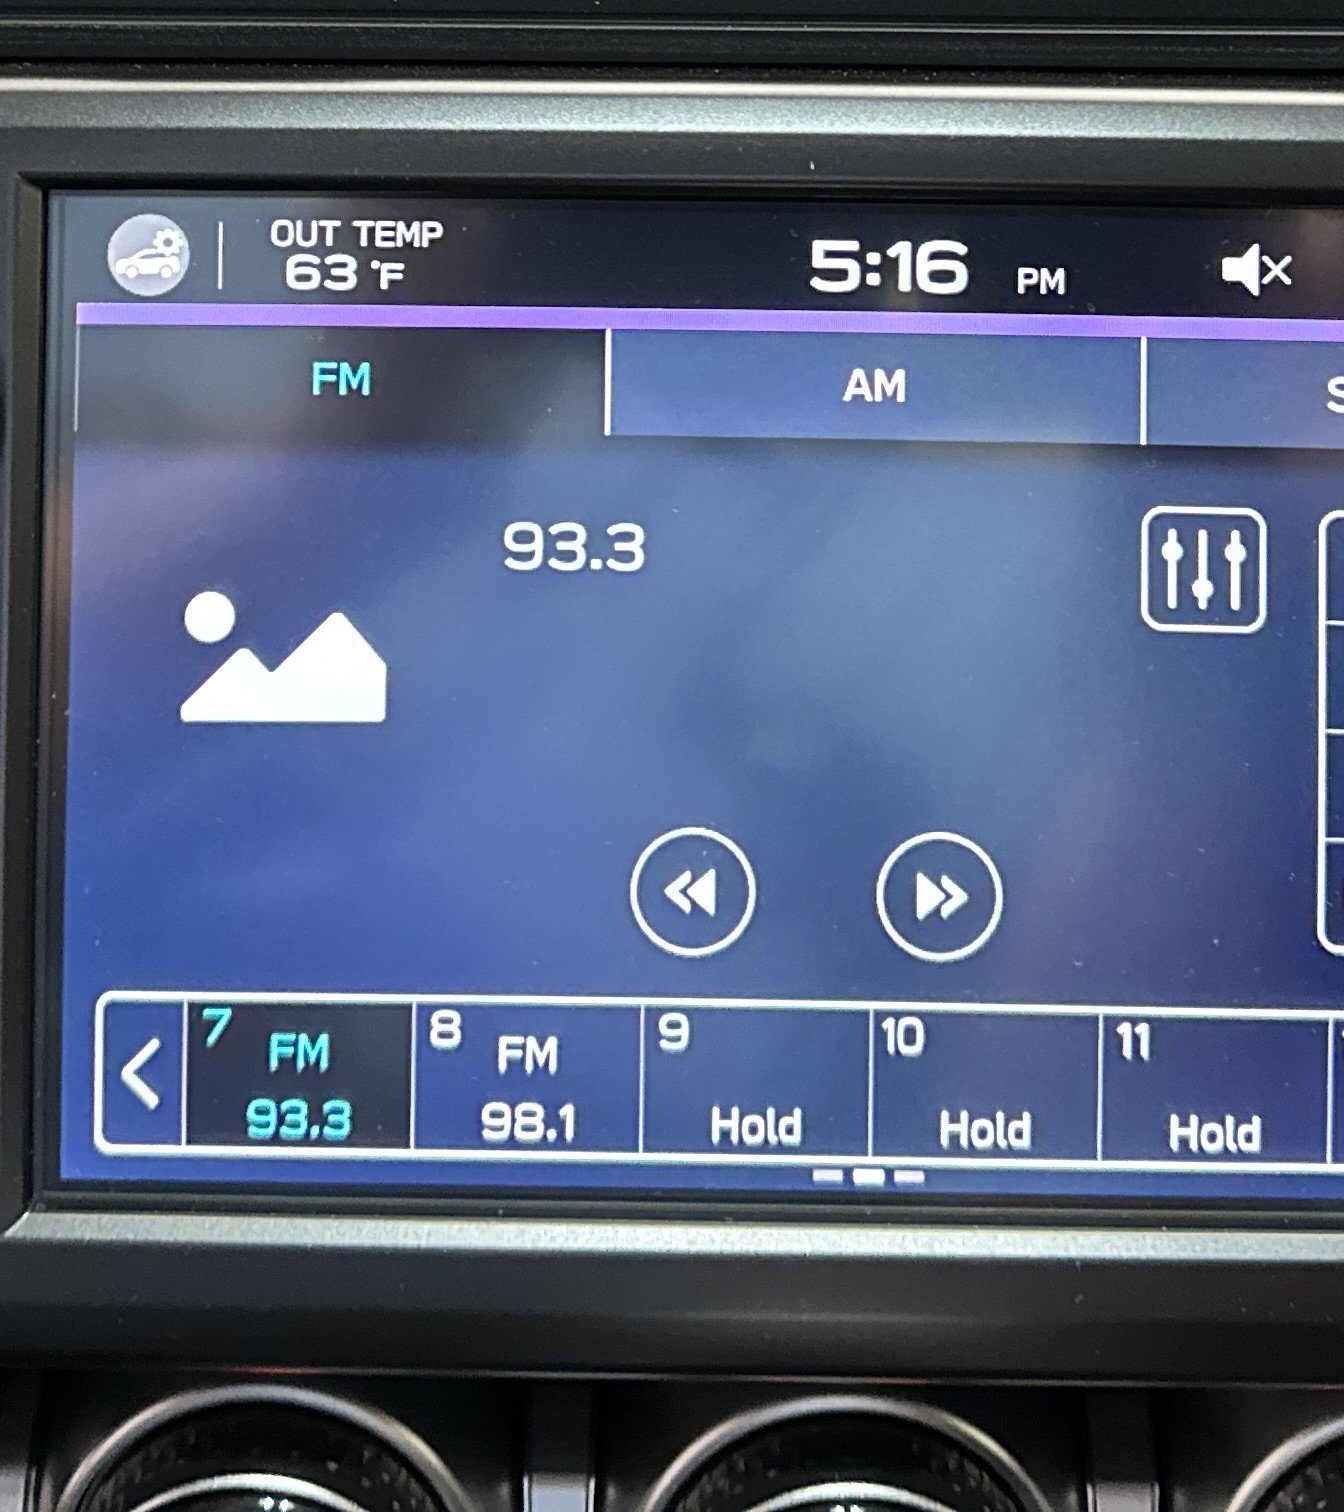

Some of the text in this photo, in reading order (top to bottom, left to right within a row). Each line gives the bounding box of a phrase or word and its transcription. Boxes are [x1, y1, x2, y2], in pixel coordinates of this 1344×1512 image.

[270, 220, 444, 249] OUT TEMP
[285, 254, 358, 291] 63
[809, 239, 1067, 296] 5:16 PM
[312, 361, 371, 396] FM
[843, 369, 906, 404] AM
[503, 521, 647, 572] 93.3
[202, 1007, 233, 1047] 7
[430, 1010, 462, 1050] 8
[658, 1012, 691, 1052] 9
[881, 1016, 926, 1058] 10
[1116, 1022, 1151, 1062] 11
[269, 1032, 330, 1074] FM
[497, 1035, 558, 1075] FM
[246, 1099, 352, 1141] 93.3
[481, 1101, 575, 1144] 98.1
[711, 1106, 802, 1146] Hold
[939, 1110, 1032, 1150] Hold
[1169, 1114, 1262, 1155] Hold
